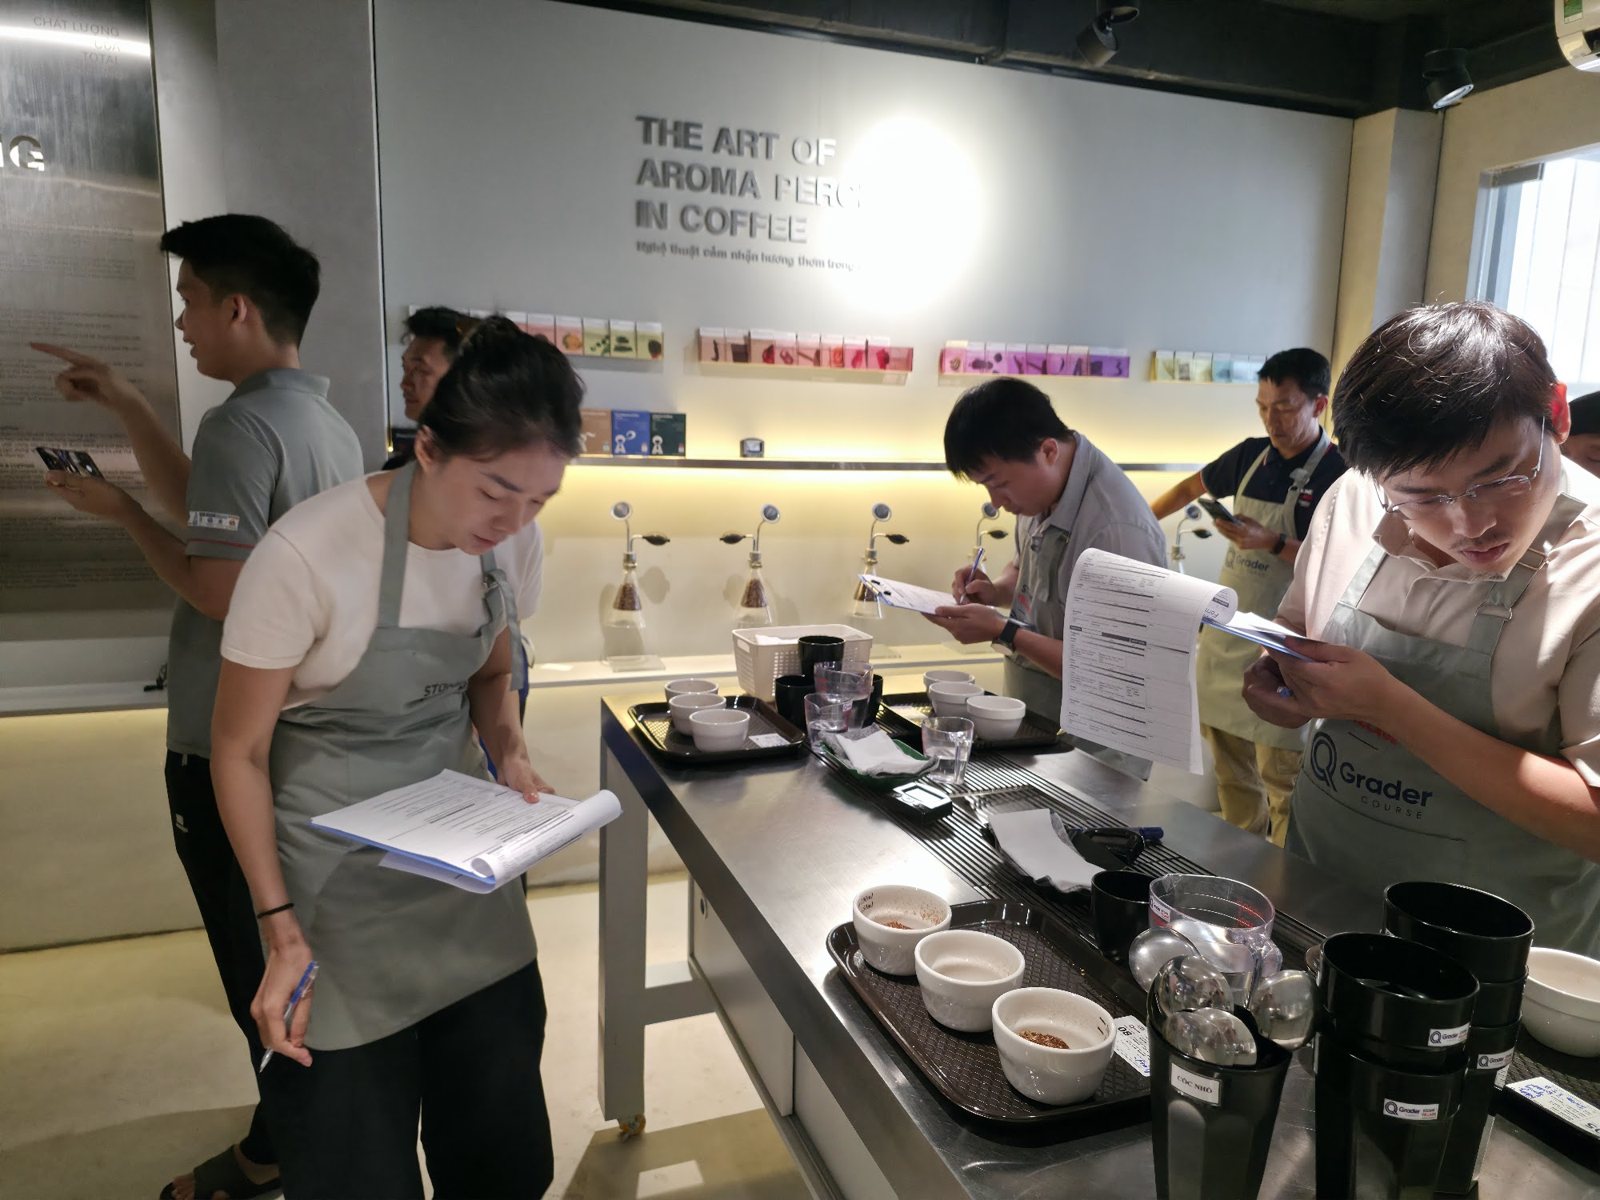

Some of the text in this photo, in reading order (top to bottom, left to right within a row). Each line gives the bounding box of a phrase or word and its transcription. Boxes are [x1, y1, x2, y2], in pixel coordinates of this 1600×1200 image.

[635, 115, 837, 166] THE ART OF
[636, 158, 761, 200] AROMA
[636, 199, 807, 244] IN COFFEE
[1339, 761, 1433, 807] Grader
[1361, 795, 1422, 820] COURSE
[1399, 1105, 1421, 1115] Grader
